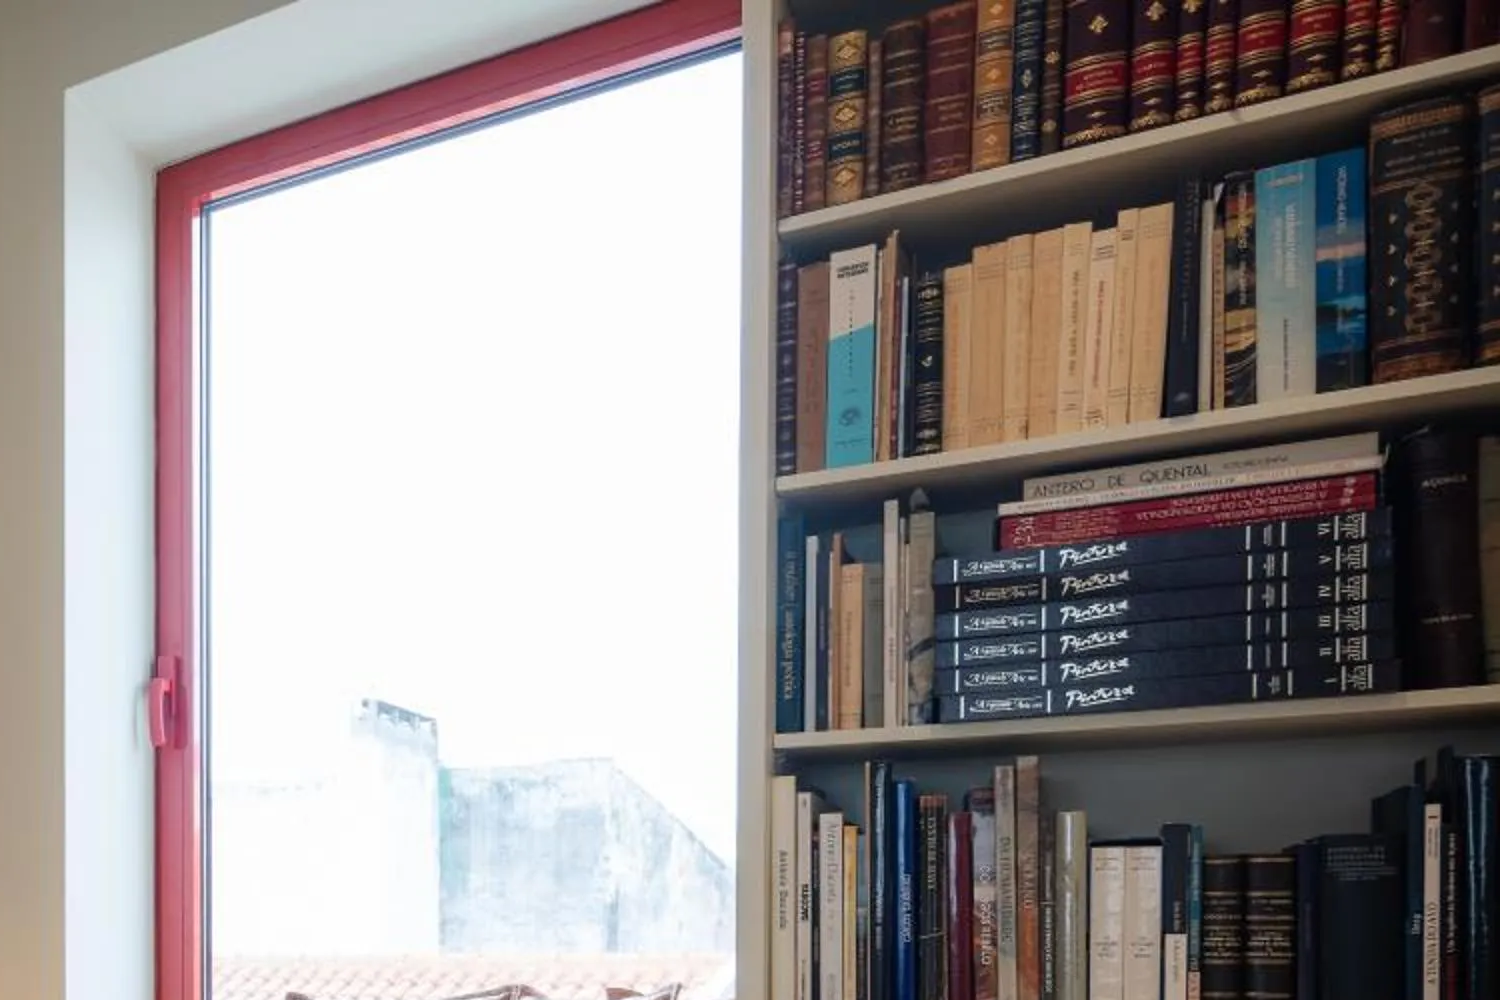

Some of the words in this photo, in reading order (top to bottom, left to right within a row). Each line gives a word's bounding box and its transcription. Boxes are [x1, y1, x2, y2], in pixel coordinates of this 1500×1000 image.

[1032, 477, 1095, 499] ANTERO
[1107, 472, 1126, 488] DE
[1139, 463, 1212, 485] QUENTAL
[1059, 541, 1128, 568] Pintura
[1060, 569, 1131, 596] Pintura
[1060, 599, 1129, 625] Pintura
[1059, 629, 1130, 655] Pintura
[1059, 657, 1130, 683] Pintura
[1065, 685, 1135, 711] Pintura
